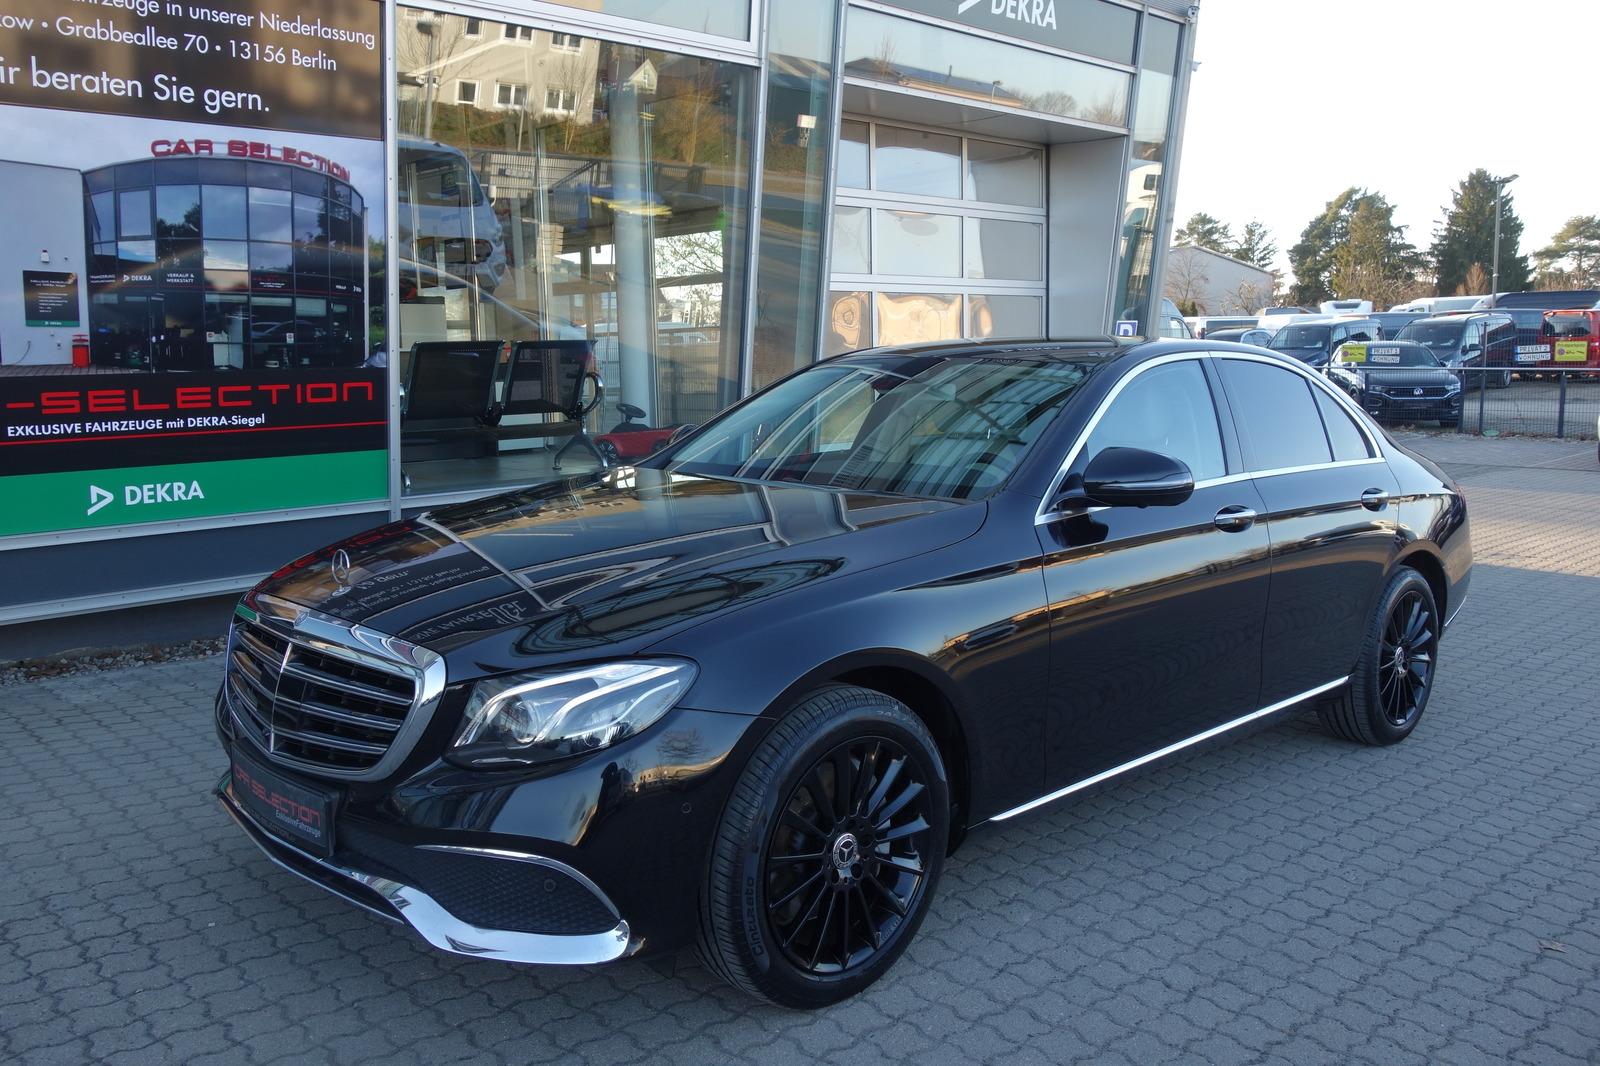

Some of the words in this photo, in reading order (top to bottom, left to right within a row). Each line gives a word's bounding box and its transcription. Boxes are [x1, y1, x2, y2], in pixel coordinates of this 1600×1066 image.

[166, 0, 182, 17] in
[189, 6, 255, 27] unserer
[260, 11, 375, 50] Niederlassung
[991, 0, 1057, 30] DEKRA
[56, 16, 178, 50] Grabbeallee
[183, 33, 209, 54] 70
[229, 40, 286, 64] 13156
[292, 48, 337, 71] Berlin
[31, 56, 143, 98] beraten
[153, 73, 195, 104] Sie
[203, 87, 270, 114] gern.
[151, 139, 213, 157] CAR
[227, 139, 351, 182] SELECTION
[7, 422, 82, 437] EXKLUSIVE
[85, 418, 163, 433] FAHRZEUGE
[166, 417, 184, 429] mit
[187, 413, 265, 428] DEKRA-Siegel
[125, 480, 205, 506] DEKRA
